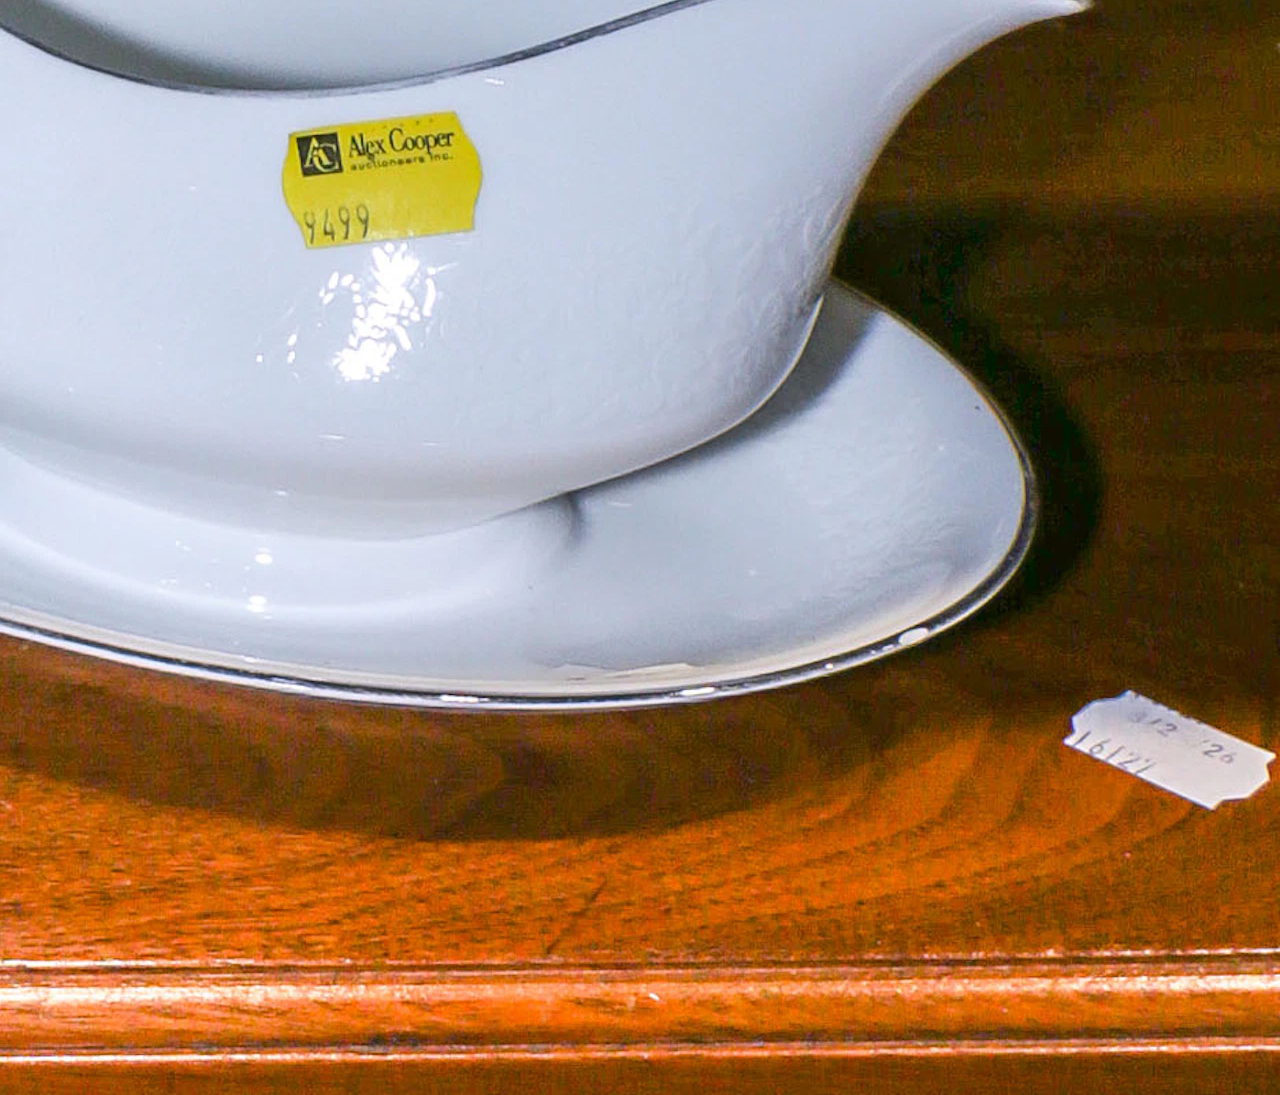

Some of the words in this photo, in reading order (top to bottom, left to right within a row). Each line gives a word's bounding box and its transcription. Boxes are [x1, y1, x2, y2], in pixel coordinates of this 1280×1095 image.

[349, 132, 386, 158] Alex
[389, 127, 455, 155] Cooper
[302, 203, 370, 245] 9499
